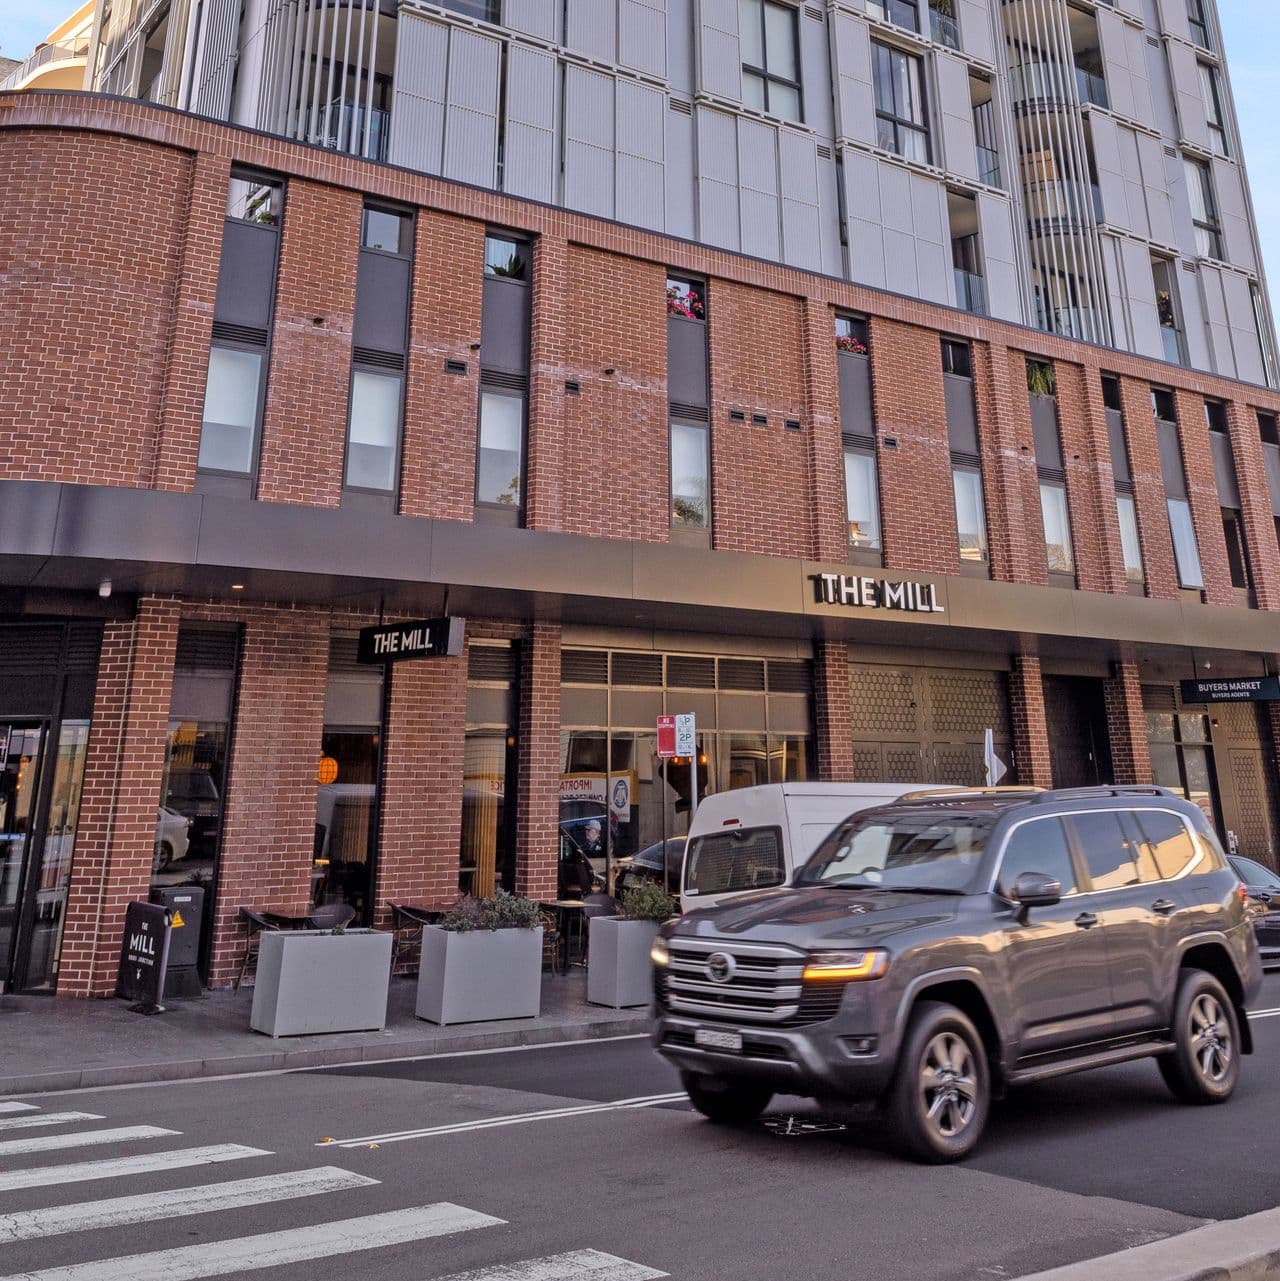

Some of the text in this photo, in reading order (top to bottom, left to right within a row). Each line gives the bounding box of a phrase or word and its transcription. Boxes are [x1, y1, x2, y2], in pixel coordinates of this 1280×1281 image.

[821, 573, 945, 612] THE MILL
[374, 627, 433, 654] THE MILL
[1198, 681, 1261, 692] BUYERS MARKET
[679, 733, 692, 742] 2P
[129, 932, 155, 956] MILL
